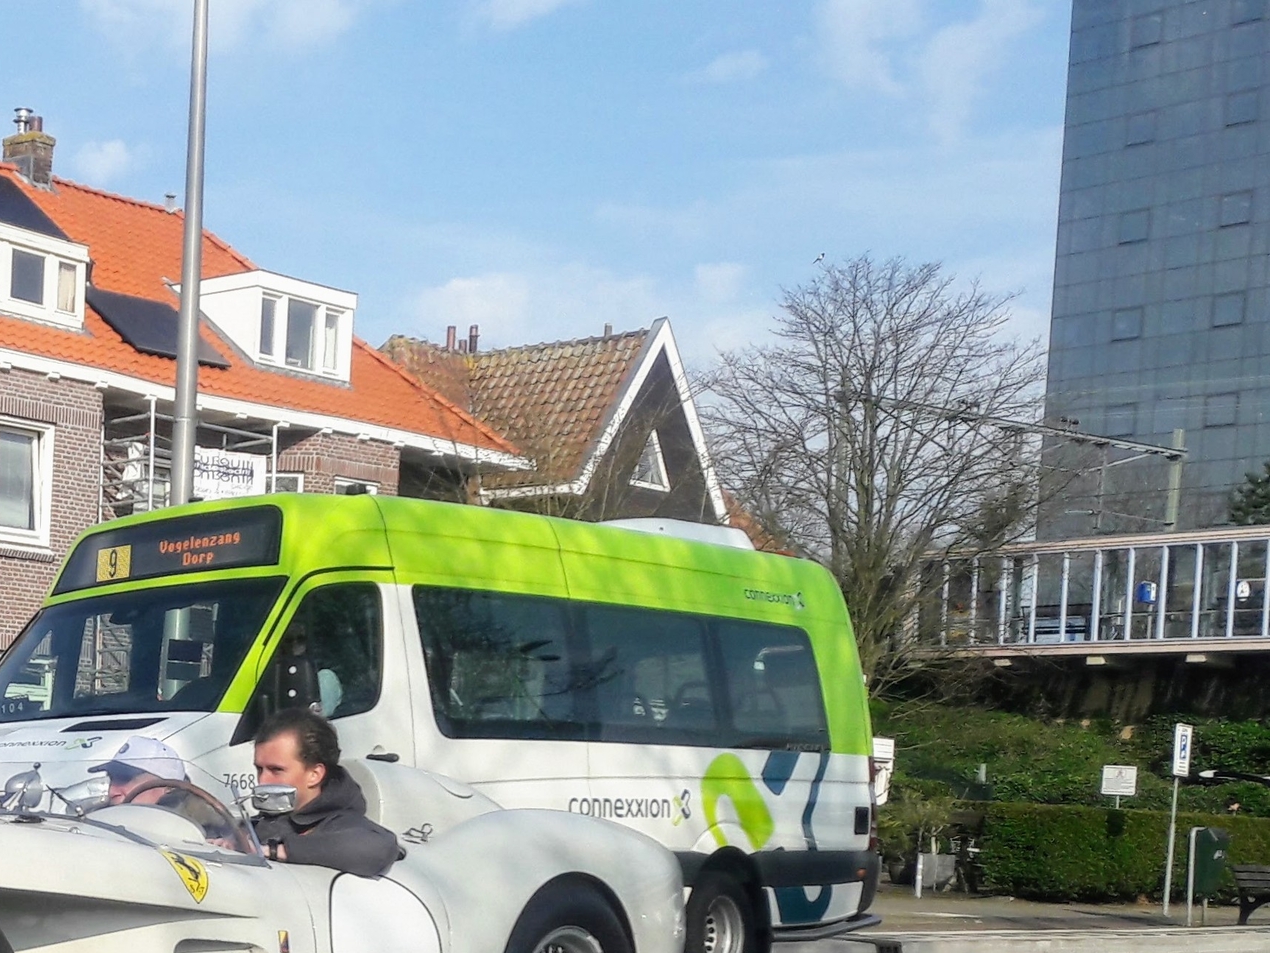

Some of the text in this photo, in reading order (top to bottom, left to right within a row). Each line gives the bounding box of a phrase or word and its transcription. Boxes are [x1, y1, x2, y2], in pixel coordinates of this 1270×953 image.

[159, 531, 241, 554] Vogelenzang
[108, 548, 118, 578] 9
[182, 552, 214, 566] Dorp
[1, 702, 23, 714] 104
[223, 773, 256, 790] 7668
[568, 797, 671, 819] connexxion
